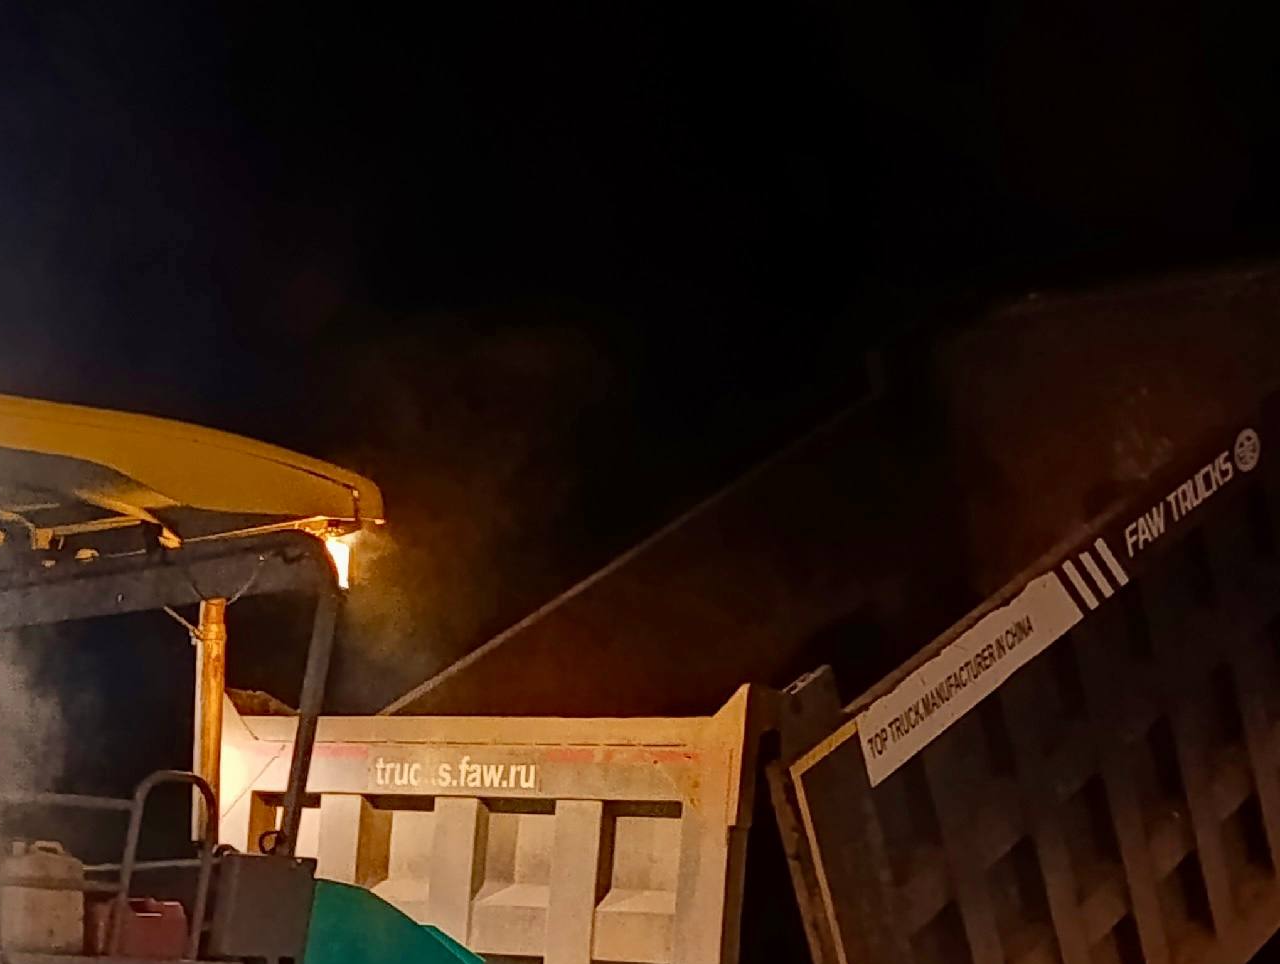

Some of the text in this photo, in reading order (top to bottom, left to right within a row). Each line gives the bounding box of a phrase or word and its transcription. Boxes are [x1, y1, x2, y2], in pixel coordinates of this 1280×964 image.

[1125, 501, 1166, 558] FAW
[867, 727, 889, 759] TOP
[887, 704, 925, 744] TRUCK
[920, 643, 997, 719] MANUFACTURER
[1005, 615, 1034, 651] CHINA
[376, 755, 536, 790] trucs.faw.ru
